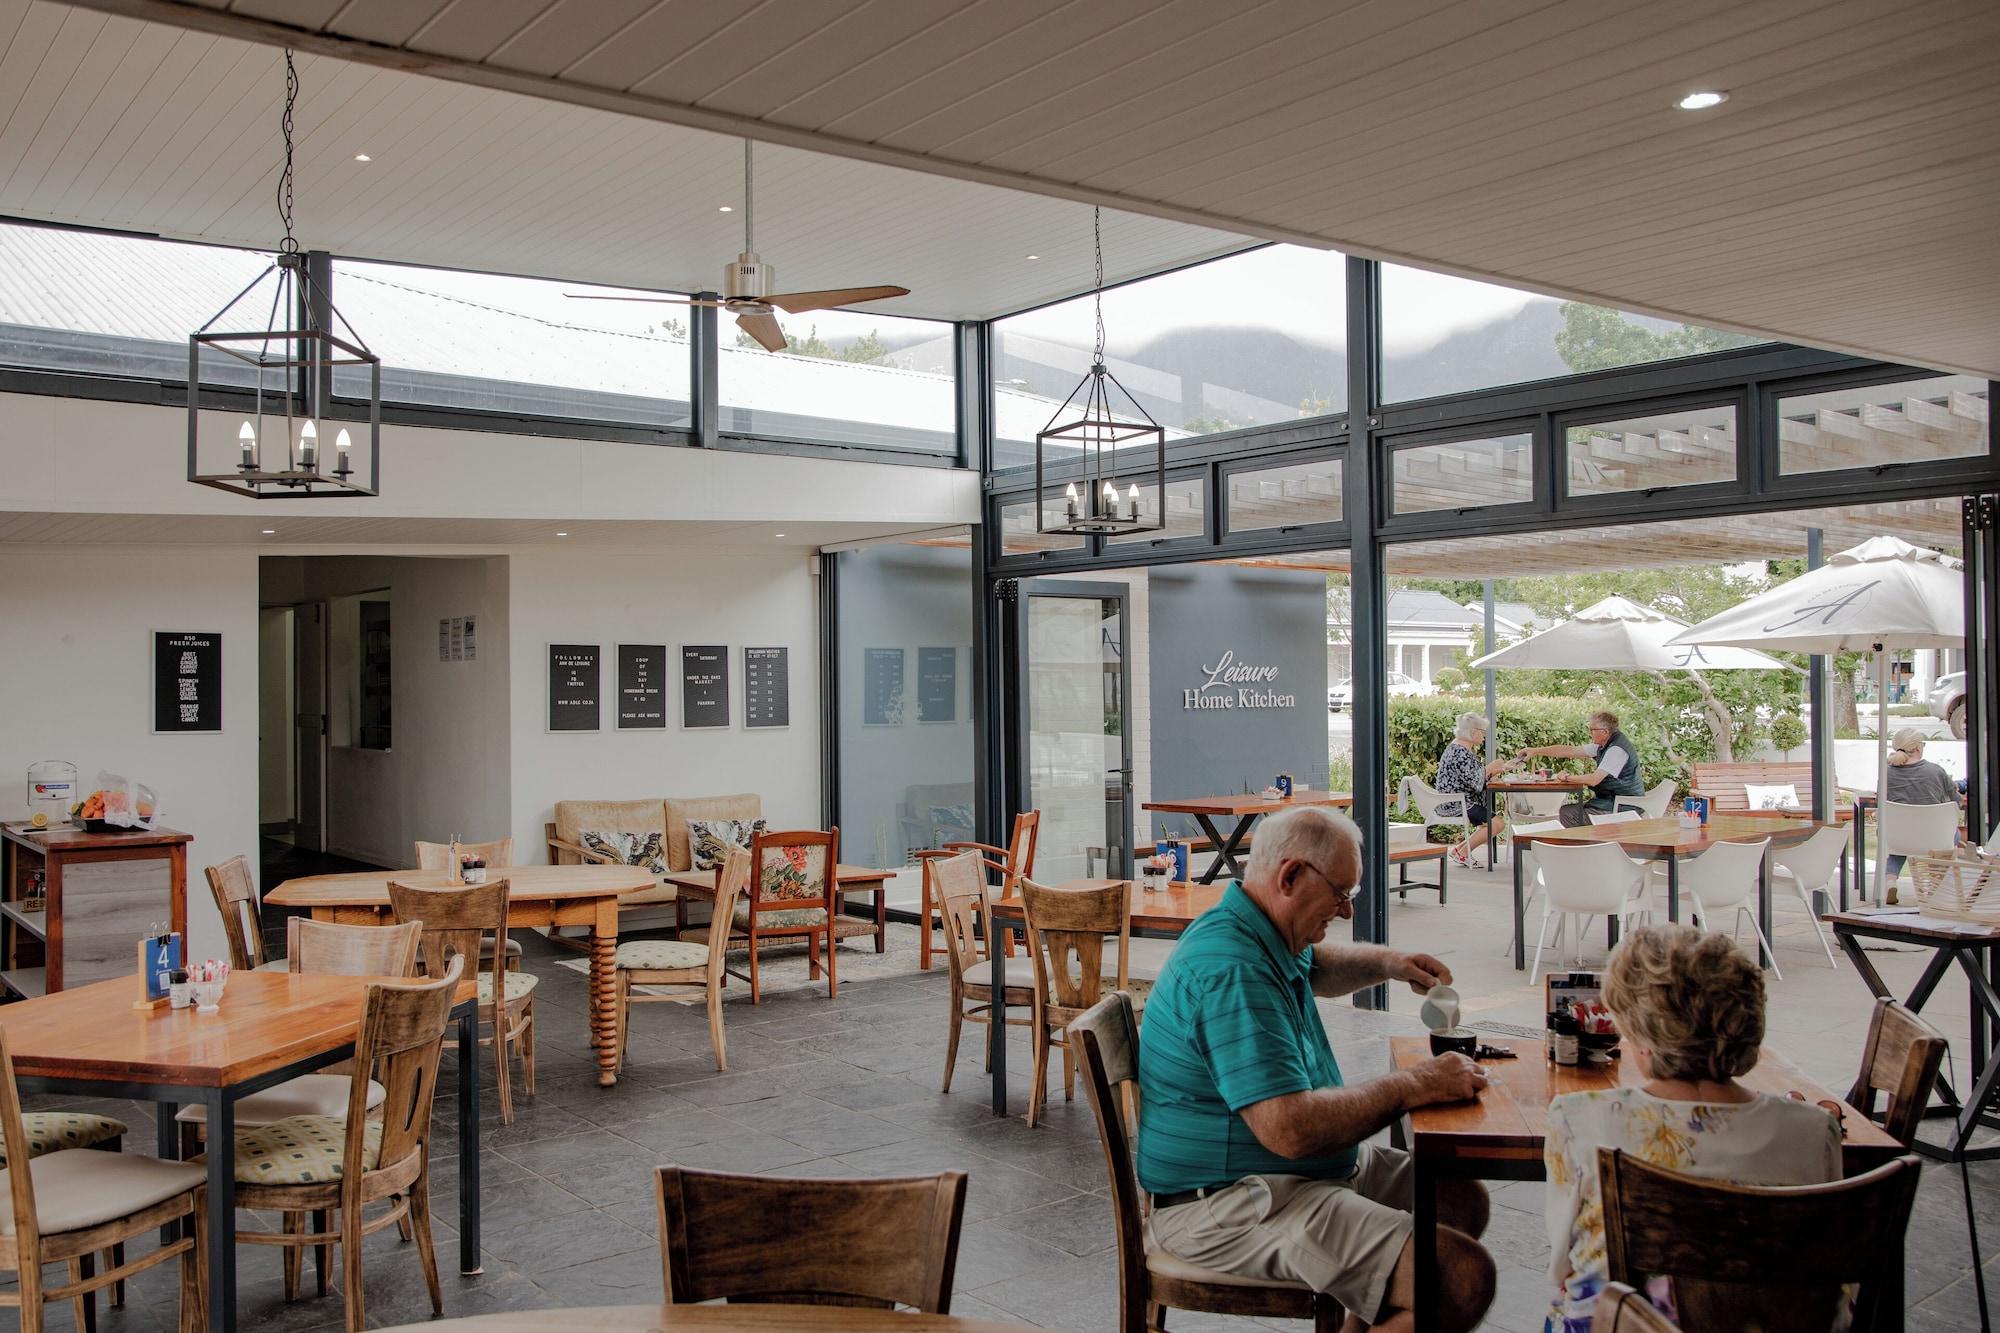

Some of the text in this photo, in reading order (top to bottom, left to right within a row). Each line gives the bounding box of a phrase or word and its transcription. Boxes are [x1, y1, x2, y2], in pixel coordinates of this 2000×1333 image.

[1201, 650, 1279, 692] Leisure
[1184, 688, 1296, 709] Home Kitchen
[1281, 779, 1287, 787] 9
[1691, 802, 1702, 812] 12
[158, 945, 169, 968] 4
